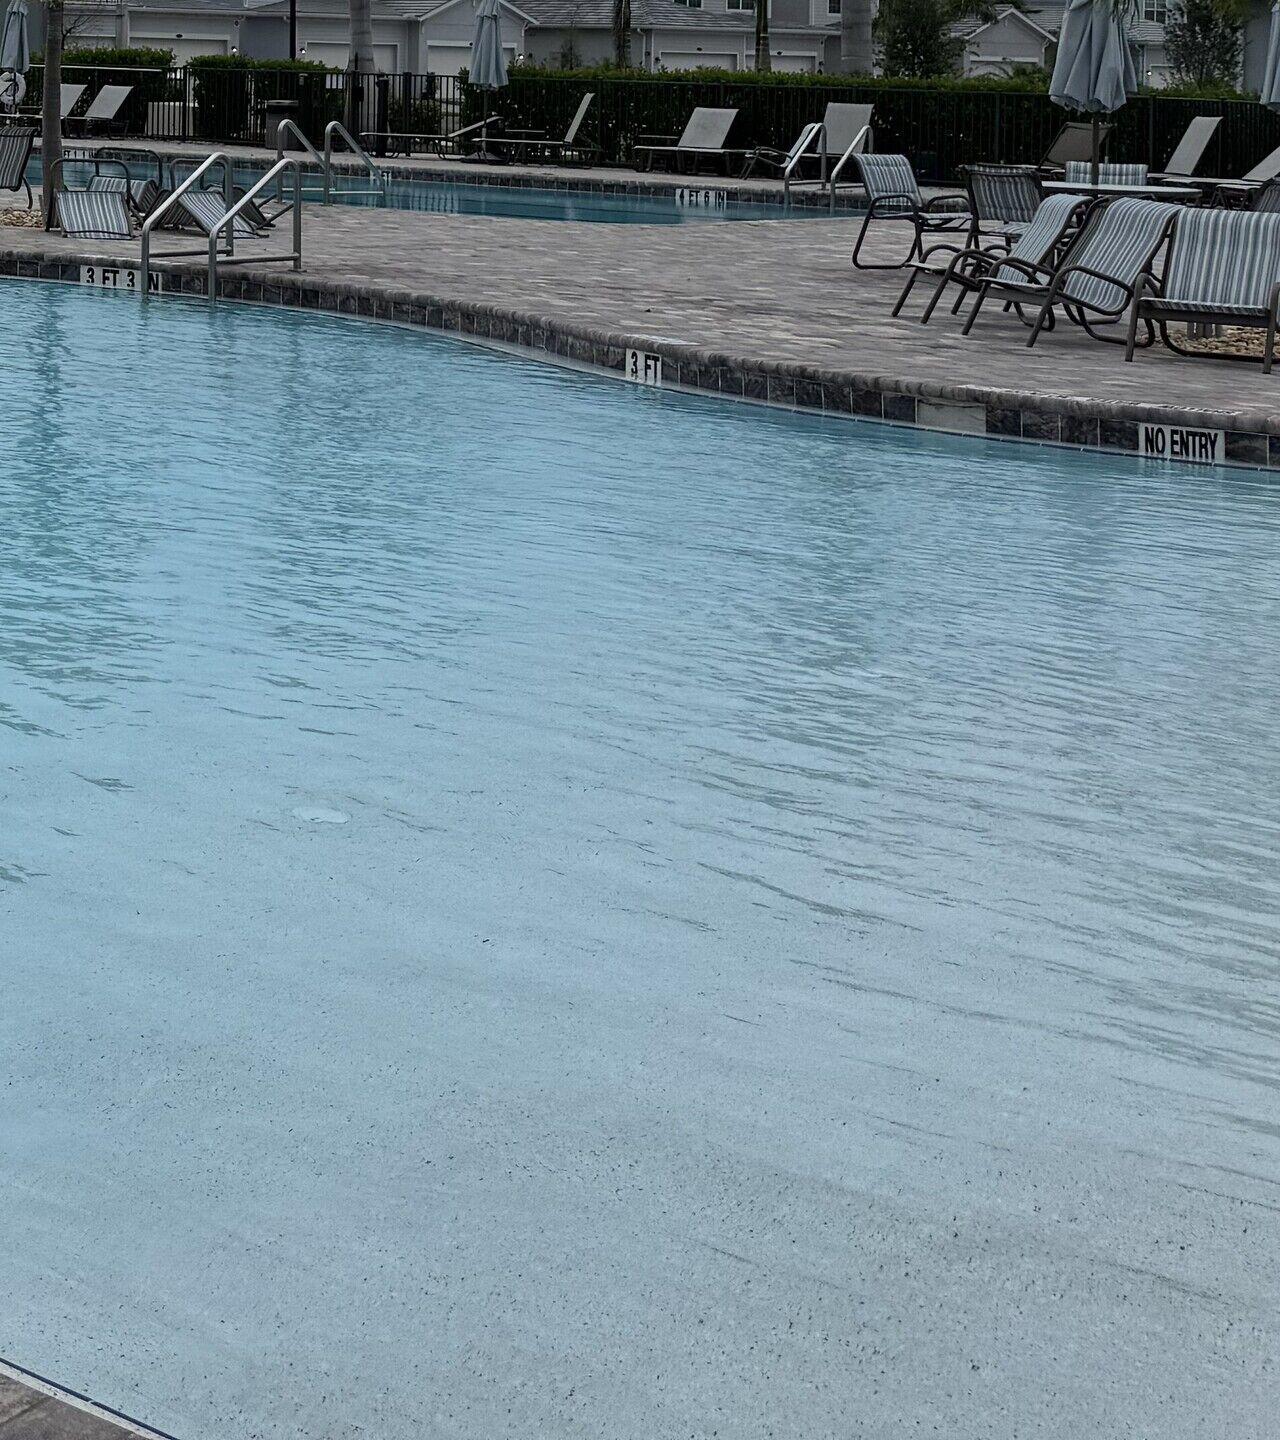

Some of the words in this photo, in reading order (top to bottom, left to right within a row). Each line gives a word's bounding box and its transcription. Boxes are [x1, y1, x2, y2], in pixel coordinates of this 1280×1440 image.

[86, 266, 95, 284] 3
[102, 268, 120, 287] FT
[126, 270, 135, 288] 3
[630, 350, 638, 376] 3
[644, 353, 660, 381] FT
[1144, 425, 1166, 454] NO
[1170, 428, 1219, 459] ENTRY
